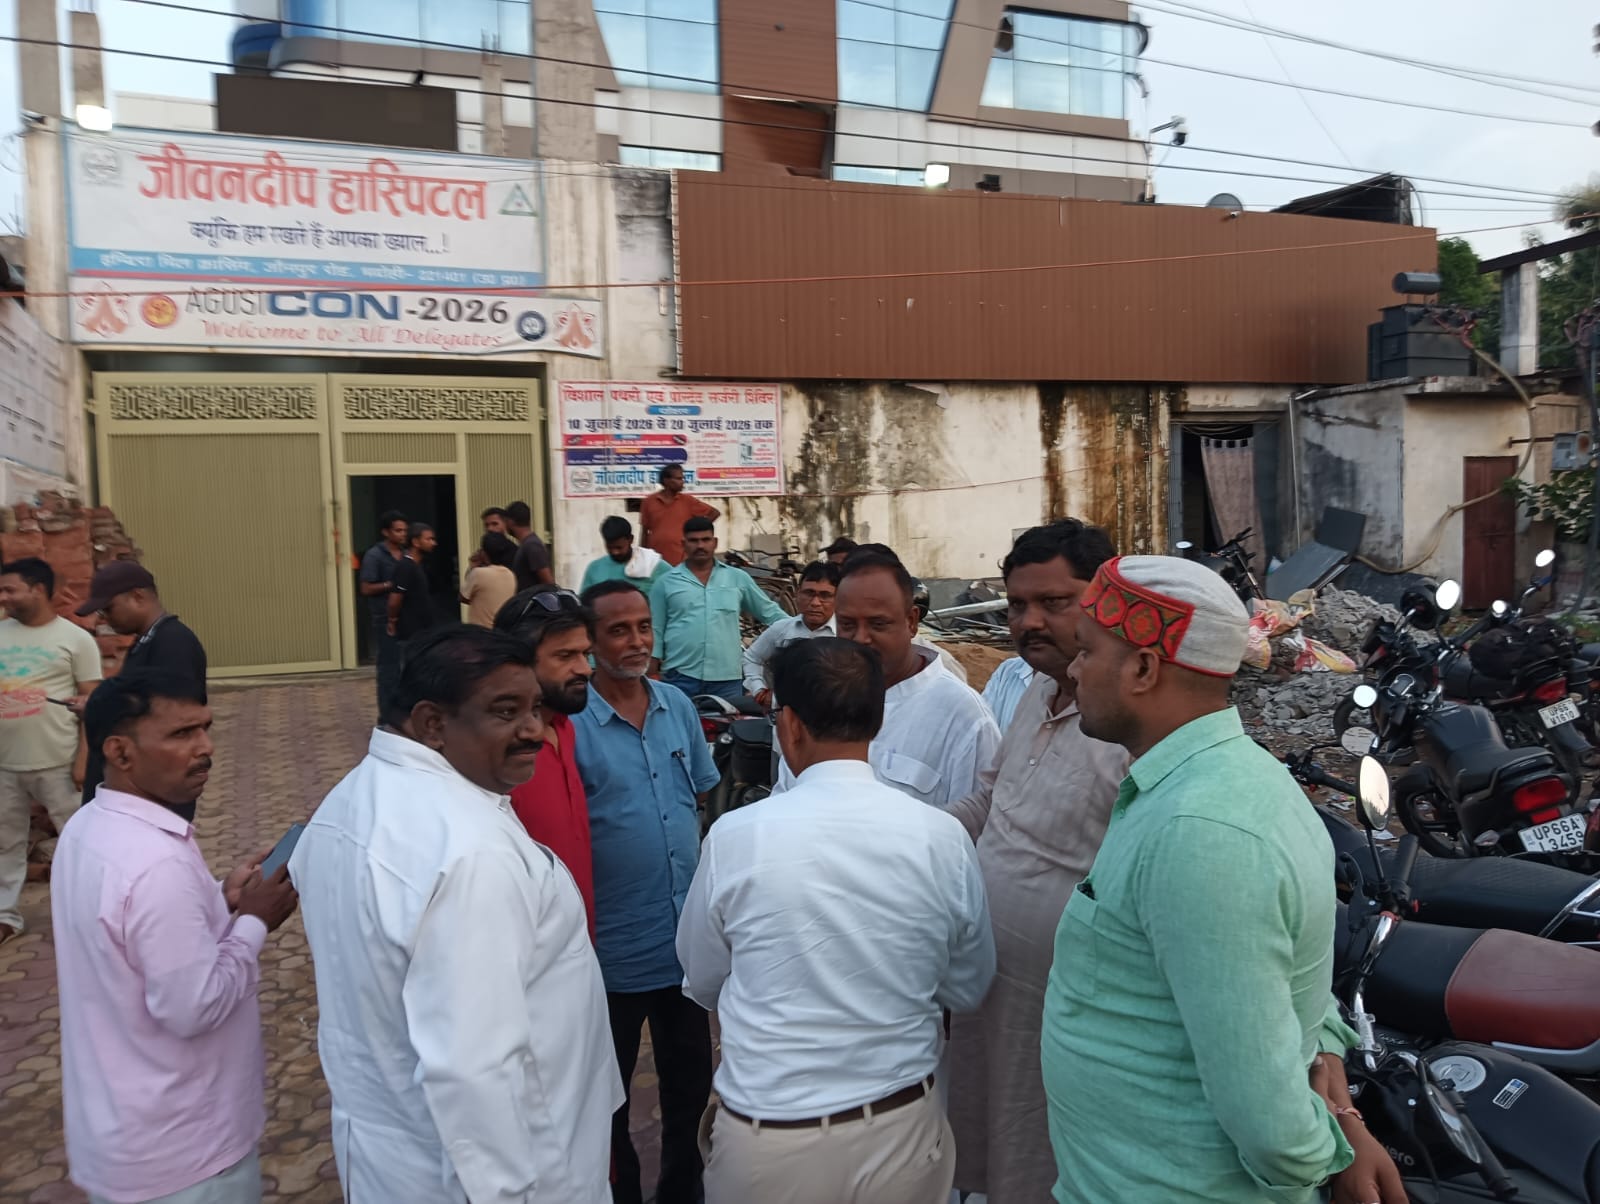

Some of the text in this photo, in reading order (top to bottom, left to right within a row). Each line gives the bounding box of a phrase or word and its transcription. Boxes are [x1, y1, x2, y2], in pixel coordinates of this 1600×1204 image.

[136, 142, 488, 221] जीवनदीप हास्पिटल
[241, 224, 266, 246] हम
[267, 220, 308, 245] रखते
[326, 229, 380, 249] आपका
[201, 319, 502, 351] Welcome to All Delegates
[568, 416, 775, 433] 10 जुलाई 2026 से 20 जुलाई 2026 तक
[1533, 818, 1580, 840] UP66A
[1386, 1145, 1415, 1166] ero
